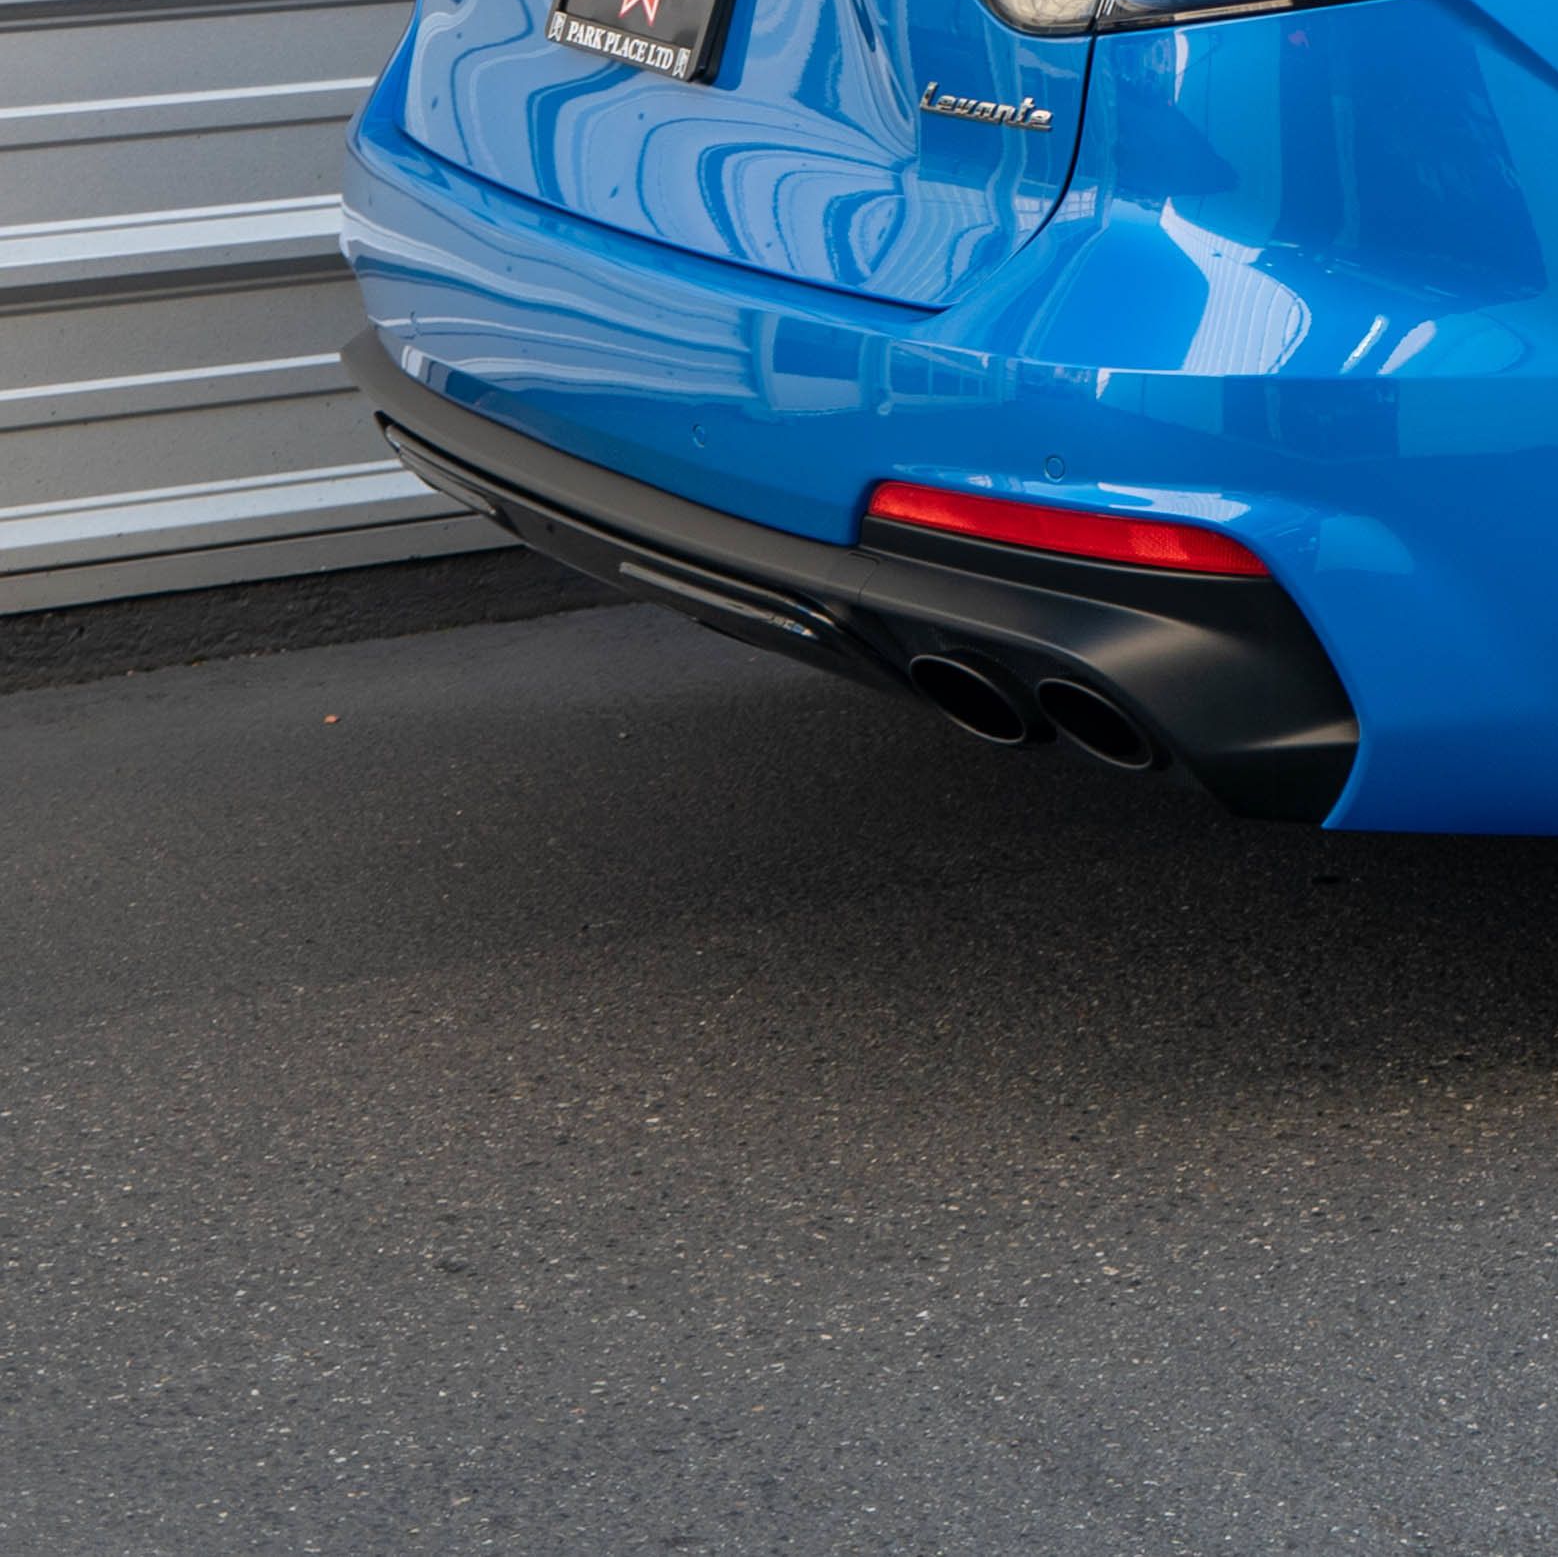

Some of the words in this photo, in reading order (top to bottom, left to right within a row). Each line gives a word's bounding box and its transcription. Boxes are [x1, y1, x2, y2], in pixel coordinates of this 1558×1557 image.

[567, 21, 606, 50] PARK
[604, 31, 646, 64] PLACE
[645, 44, 674, 70] LTD
[919, 81, 1053, 131] Levante
